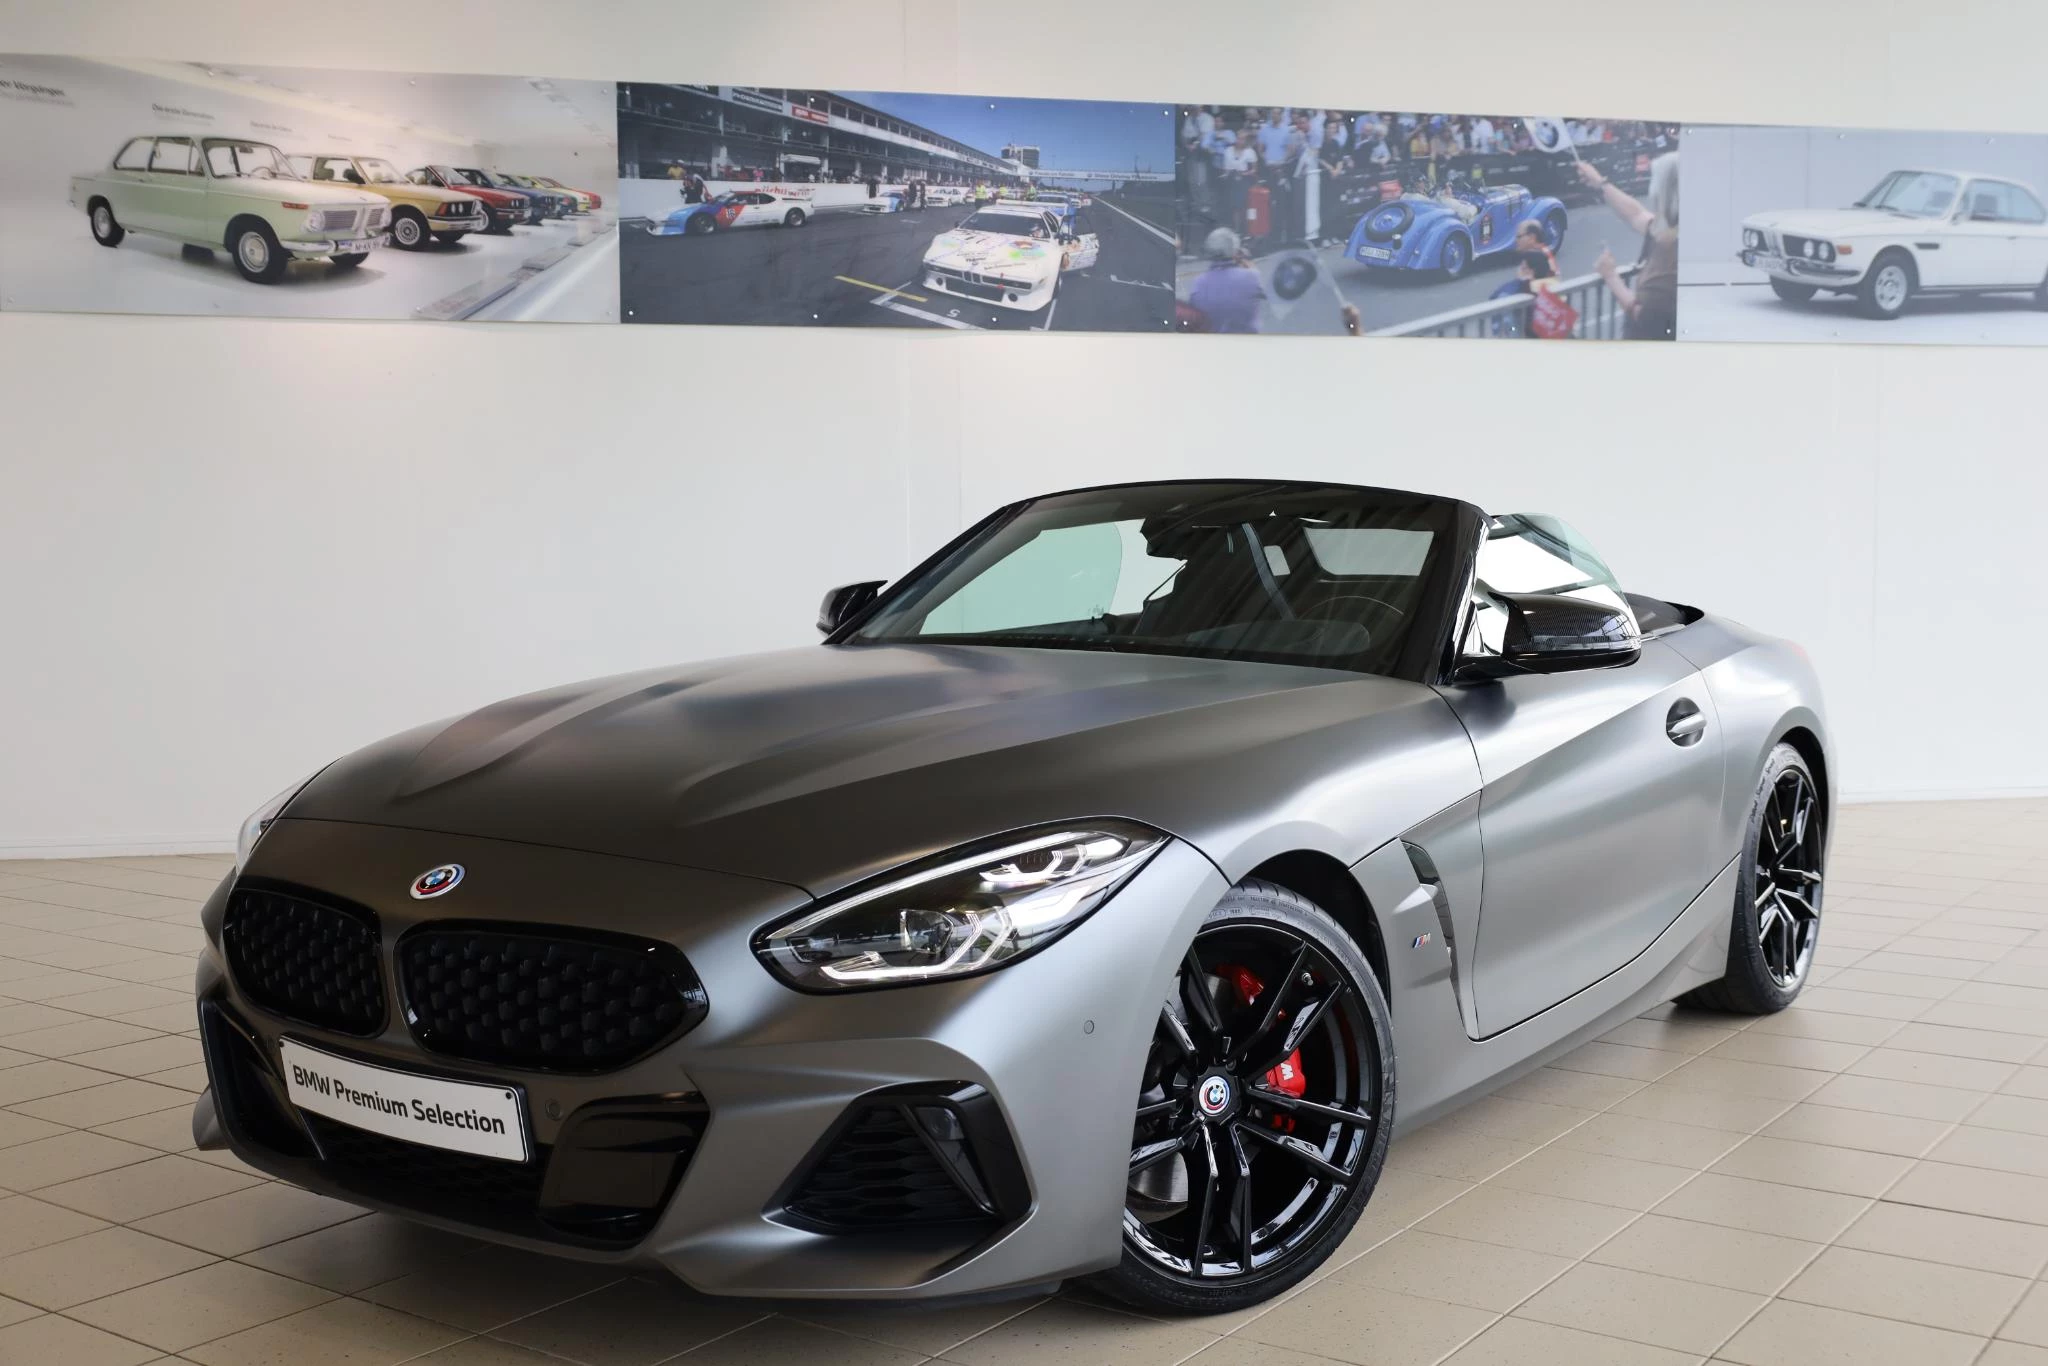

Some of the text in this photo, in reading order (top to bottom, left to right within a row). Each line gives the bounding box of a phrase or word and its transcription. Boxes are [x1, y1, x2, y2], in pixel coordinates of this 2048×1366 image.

[293, 1065, 505, 1134] BMW Premium Selection
